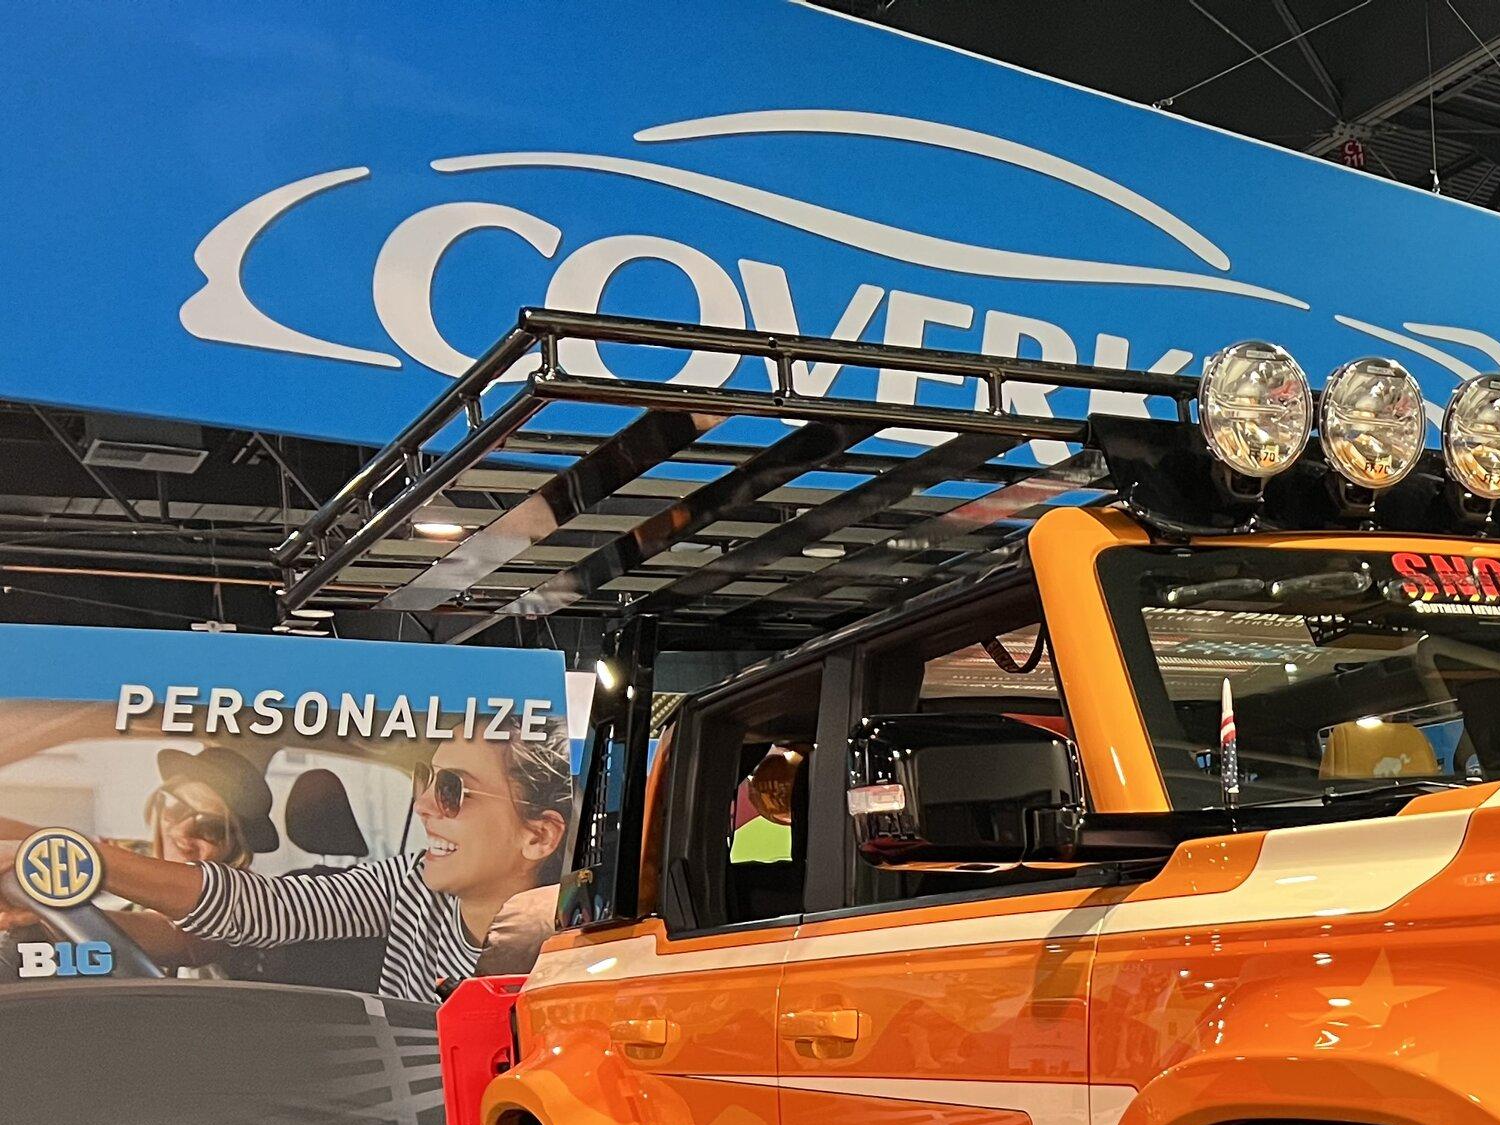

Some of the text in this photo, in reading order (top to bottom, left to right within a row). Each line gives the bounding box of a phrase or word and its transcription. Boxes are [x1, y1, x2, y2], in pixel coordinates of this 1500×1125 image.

[1416, 602, 1473, 615] SOUTHERN
[115, 684, 552, 742] PERSONALIZE
[29, 843, 90, 894] SEC
